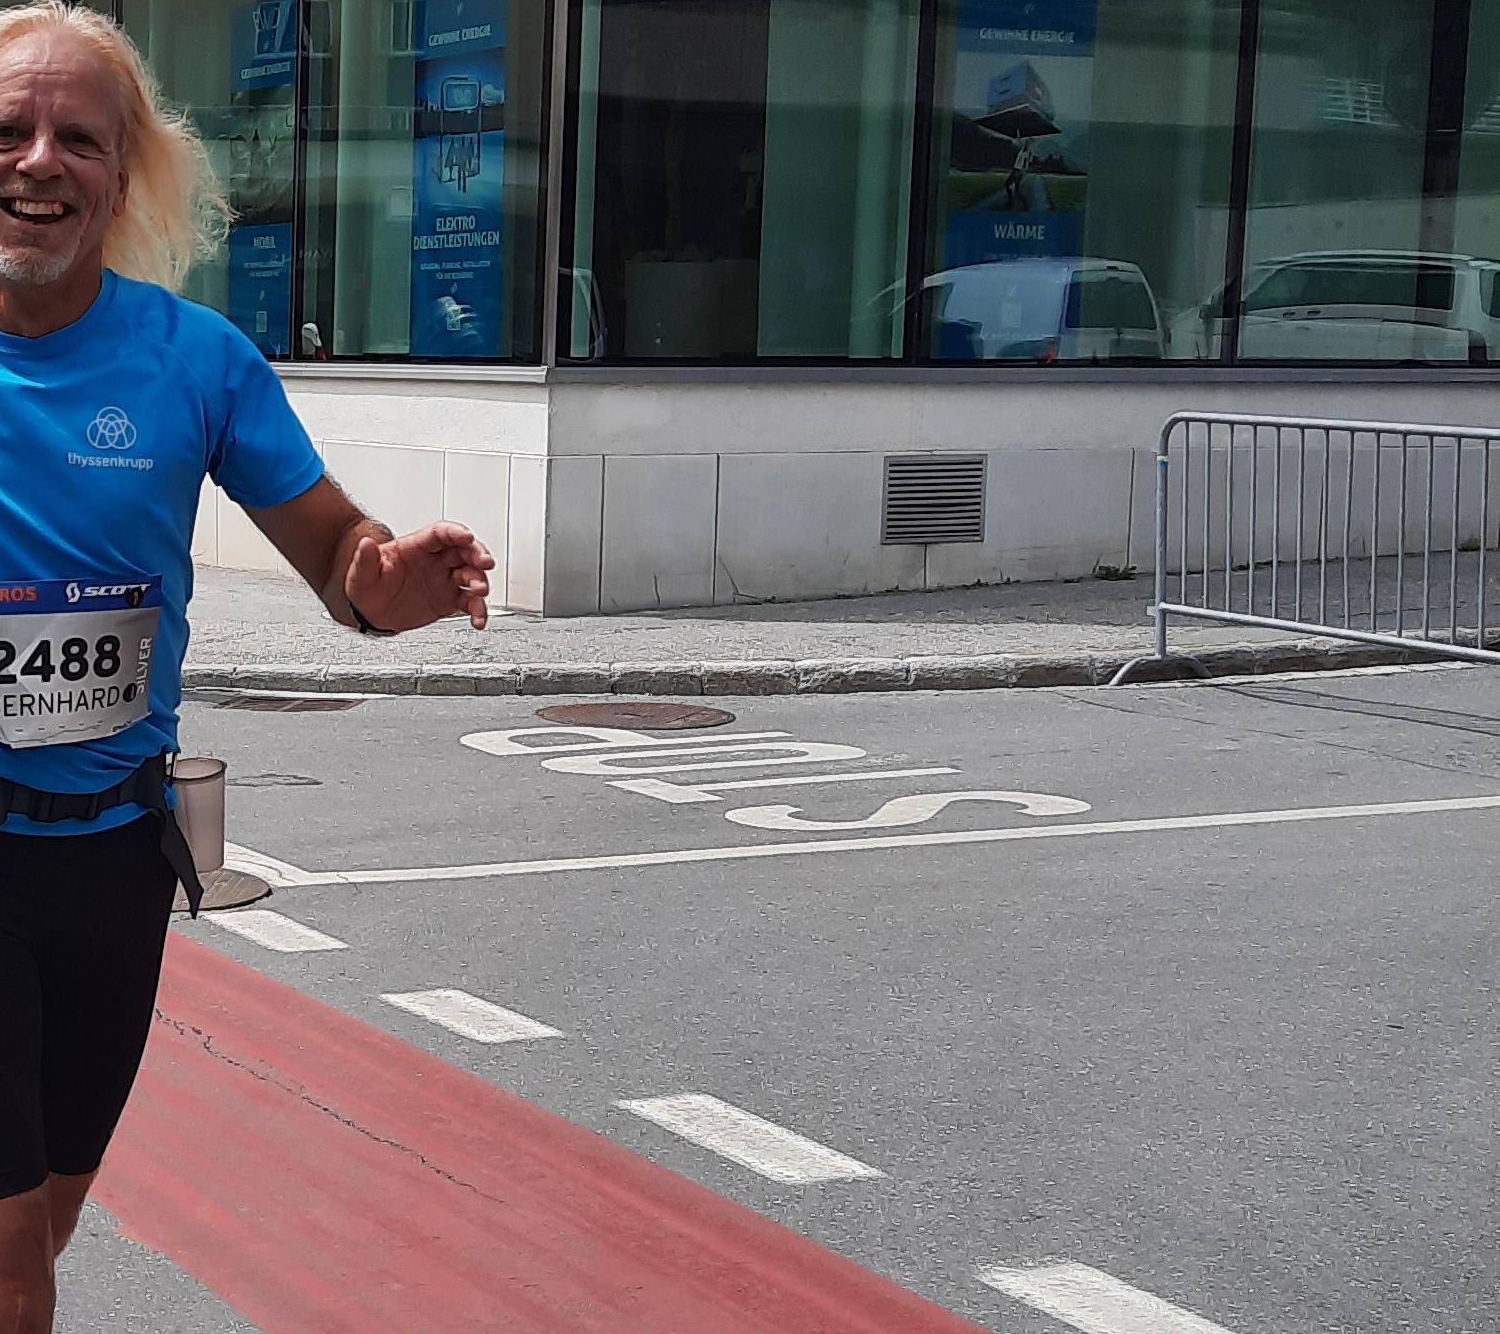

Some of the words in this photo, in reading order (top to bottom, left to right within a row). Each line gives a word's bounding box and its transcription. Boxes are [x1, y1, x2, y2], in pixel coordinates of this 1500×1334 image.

[436, 214, 476, 232] ELEKTRO
[994, 221, 1045, 240] WÄRME
[413, 229, 500, 250] DIENSTLEISTUNGEN
[67, 451, 154, 471] thyssenkrupp
[136, 636, 153, 695] SILVER
[459, 726, 1093, 832] STOP
